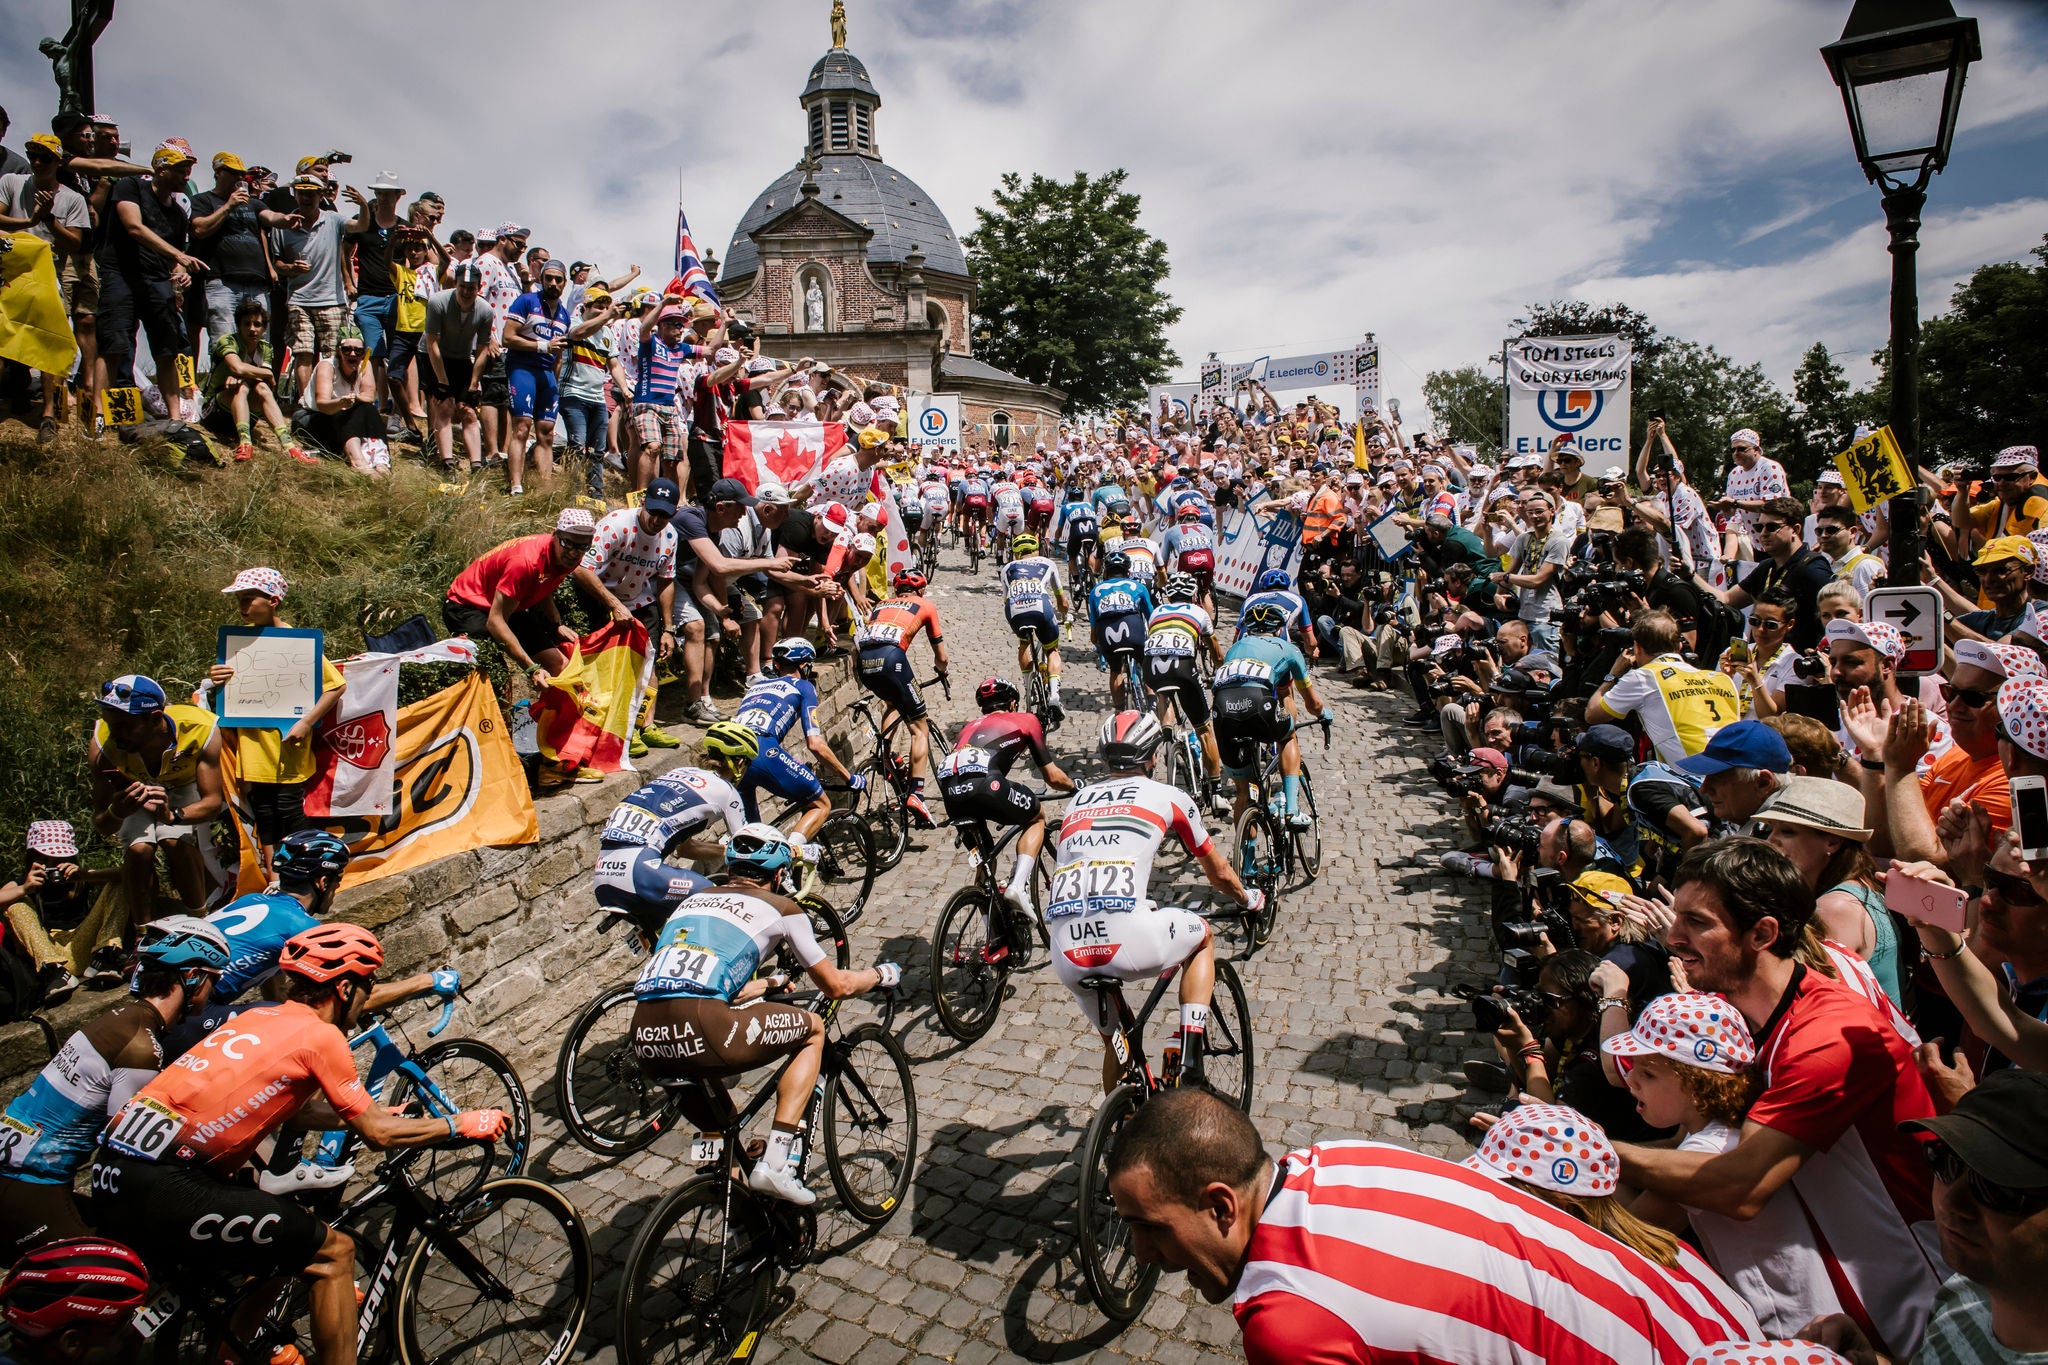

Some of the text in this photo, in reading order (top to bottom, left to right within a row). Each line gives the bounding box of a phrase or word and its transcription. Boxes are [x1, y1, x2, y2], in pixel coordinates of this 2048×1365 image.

[1520, 345, 1615, 361] TOM STEELS
[1269, 365, 1314, 379] E.Leclerc
[1520, 369, 1571, 384] GLORY
[1272, 518, 1301, 543] HLN
[881, 626, 898, 638] 44
[1172, 635, 1189, 649] 62
[1246, 661, 1266, 678] 77
[745, 711, 767, 726] 25
[1704, 700, 1721, 722] 3
[967, 748, 980, 764] 3
[948, 782, 974, 795] INEOS
[1075, 786, 1139, 807] UAE
[1007, 787, 1032, 810] INEOS
[1069, 804, 1131, 822] Emirates
[617, 810, 655, 837] 194
[1066, 833, 1121, 850] EMAAR
[1087, 865, 1135, 897] 123
[678, 902, 755, 924] MONDIALE
[725, 898, 746, 909] LA
[1070, 920, 1108, 941] UAE
[626, 934, 642, 955] 194
[1073, 945, 1113, 959] Emirates
[296, 962, 328, 978] GIANT
[669, 949, 708, 981] 34
[764, 1012, 805, 1029] AG2R LA
[635, 1021, 695, 1042] AG2R LA
[760, 1026, 808, 1045] MONDIALE
[634, 1037, 706, 1059] MONDIALE
[1114, 1034, 1125, 1060] 123
[191, 1074, 293, 1144] VÖGELE SHOES
[114, 1107, 174, 1153] 116
[699, 1141, 714, 1159] 34
[92, 1163, 121, 1194] CCC
[190, 1213, 282, 1244] CCC
[77, 1273, 127, 1283] BONTRAGER
[66, 1301, 99, 1312] TREK
[140, 1296, 175, 1333] 116
